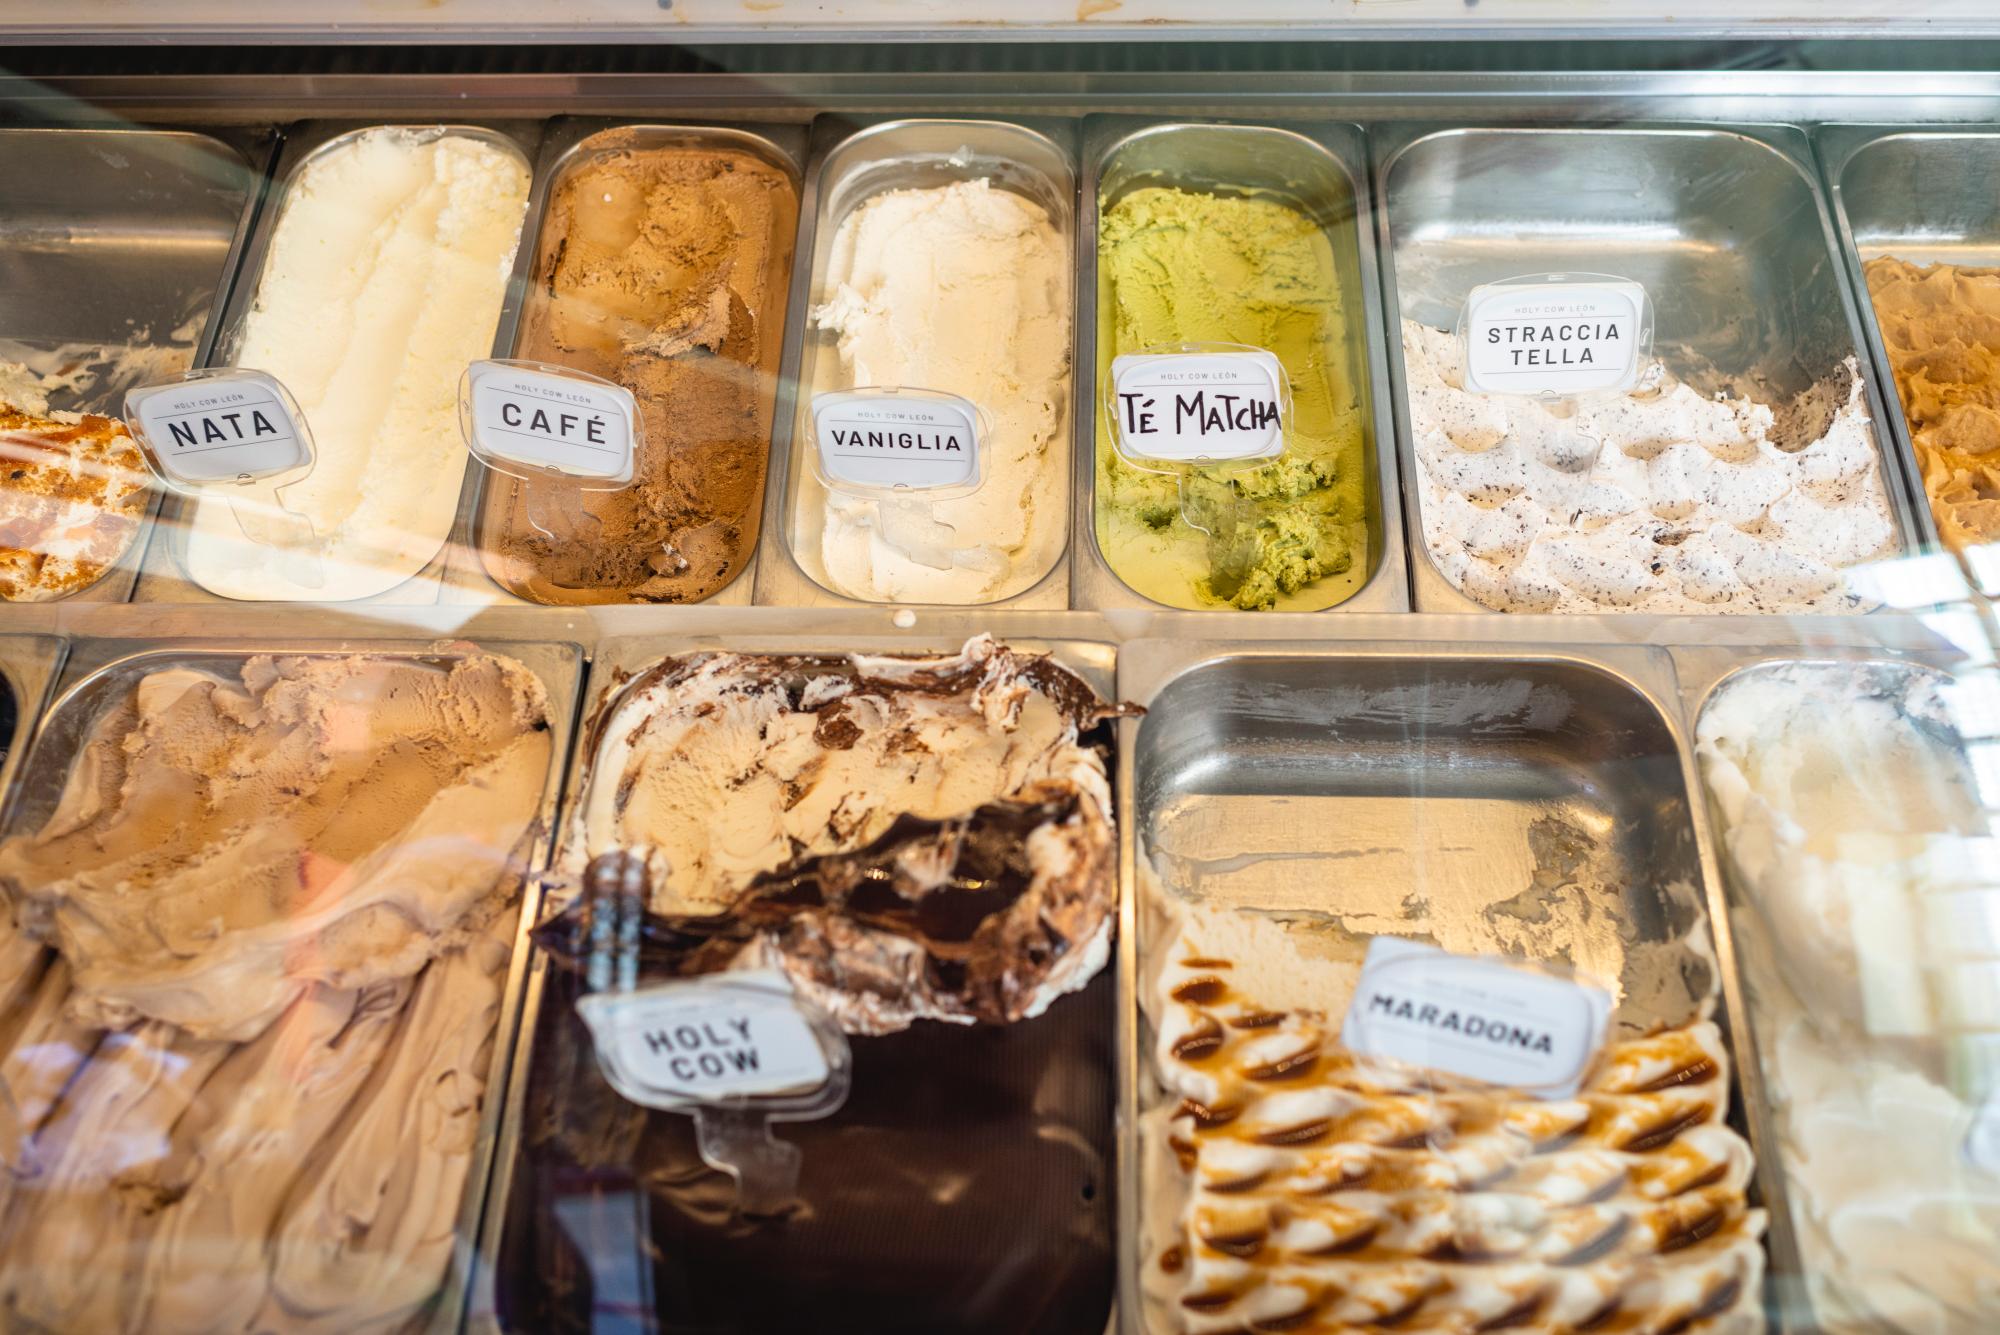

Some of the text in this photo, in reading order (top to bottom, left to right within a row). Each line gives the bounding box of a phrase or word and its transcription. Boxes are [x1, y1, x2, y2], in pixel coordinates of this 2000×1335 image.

[1515, 306, 1540, 314] HOLY
[1544, 305, 1565, 313] COW
[1488, 323, 1619, 344] STRACCIA
[1510, 347, 1594, 366] TELLA
[1188, 372, 1208, 380] COW
[515, 383, 539, 393] HOLY
[542, 388, 562, 398] COW
[174, 401, 197, 410] HOLY
[199, 397, 218, 406] COW
[1119, 393, 1159, 434] TÉ
[502, 403, 606, 444] CAFÉ
[857, 411, 881, 419] HOLY
[885, 412, 905, 420] COW
[168, 410, 278, 447] NATA
[831, 430, 961, 451] VANIGLIA
[1370, 994, 1553, 1055] MARADONA
[644, 1017, 751, 1054] HOLY
[670, 1048, 760, 1082] COW
